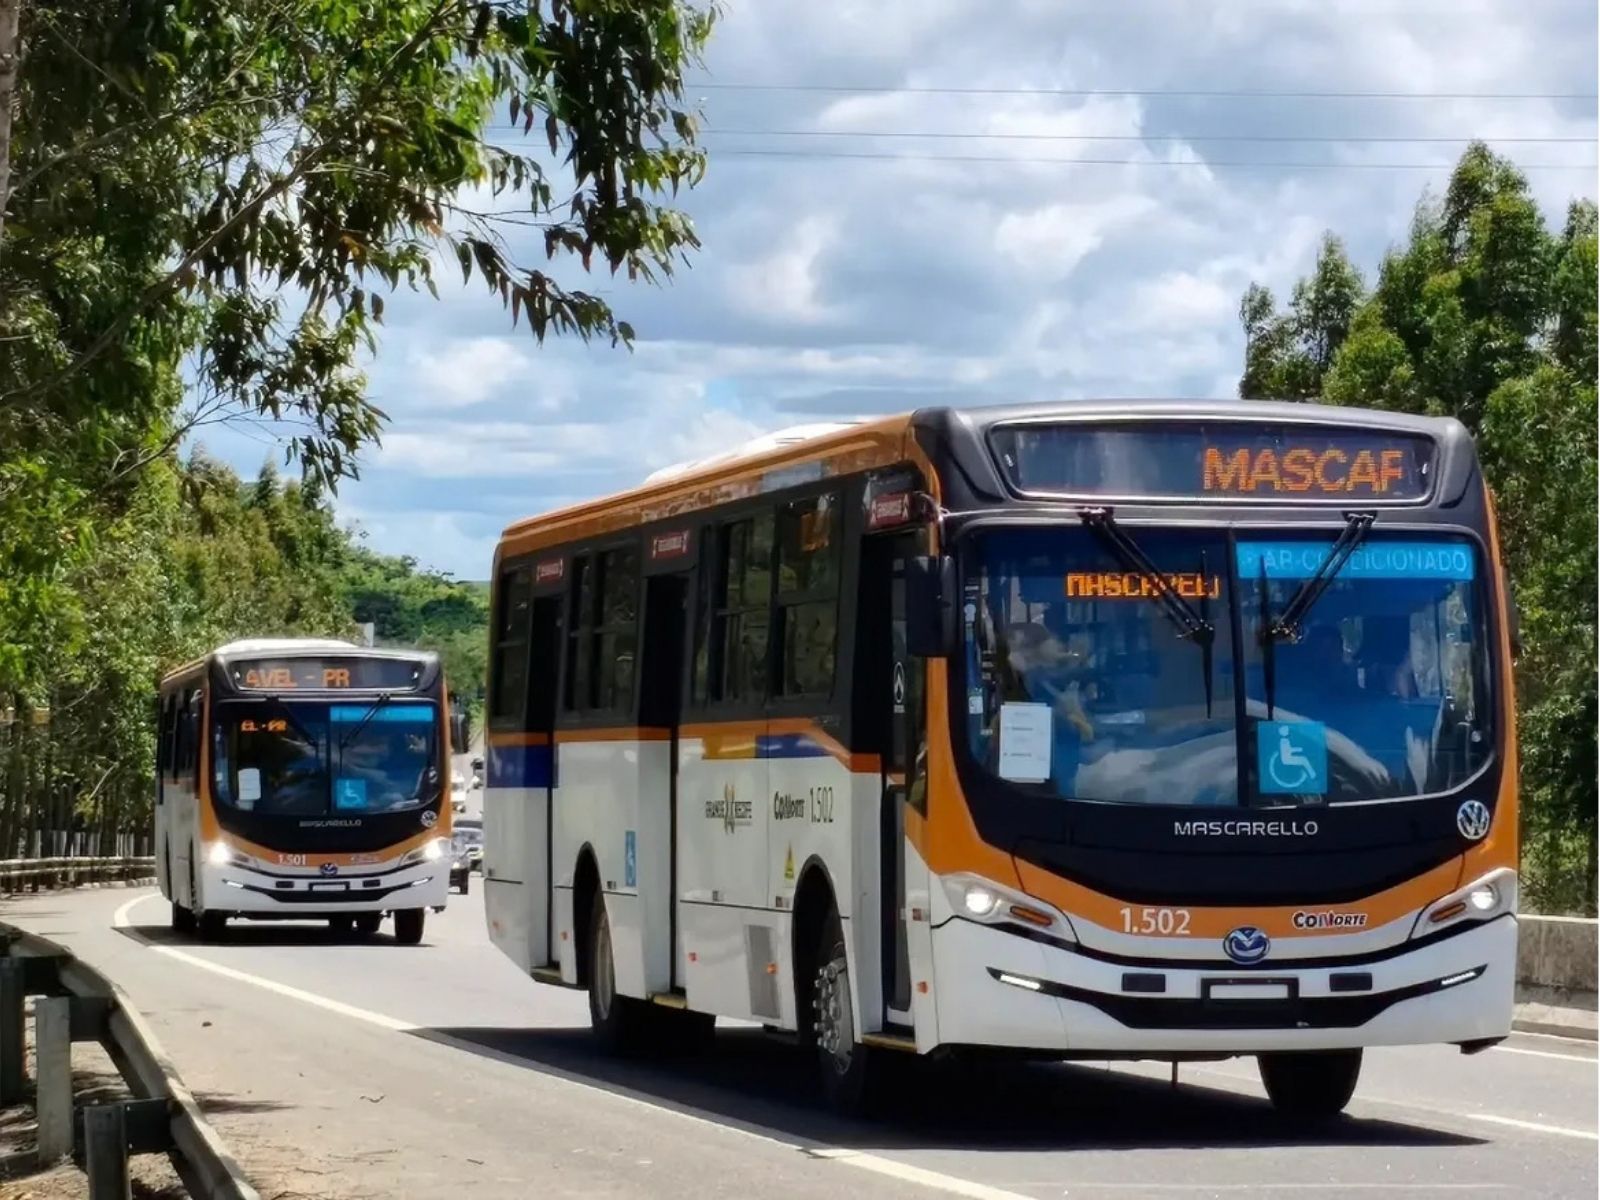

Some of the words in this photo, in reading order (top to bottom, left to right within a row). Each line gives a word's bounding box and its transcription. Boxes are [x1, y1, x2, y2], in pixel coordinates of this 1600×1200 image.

[323, 668, 350, 688] PR
[810, 786, 833, 822] 1.502
[1174, 821, 1319, 836] MASCARELLO
[278, 854, 307, 866] 1.501
[1119, 907, 1191, 935] 1.502
